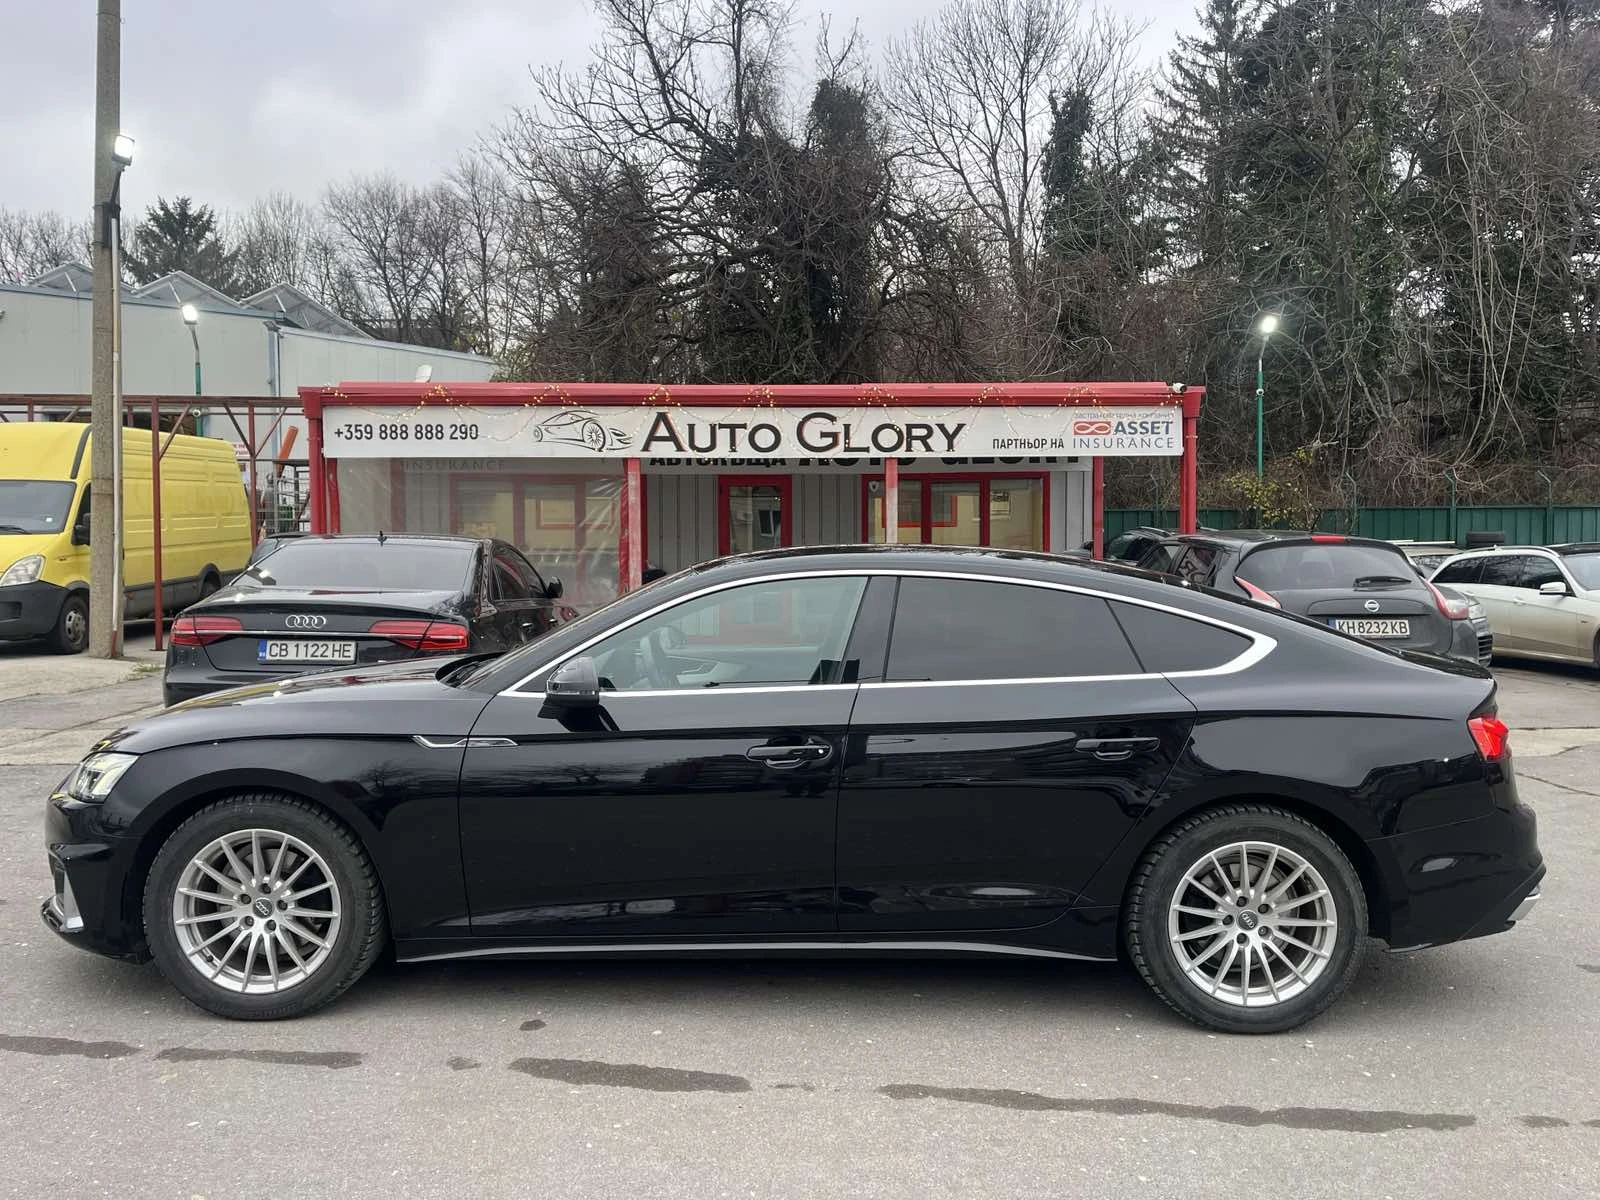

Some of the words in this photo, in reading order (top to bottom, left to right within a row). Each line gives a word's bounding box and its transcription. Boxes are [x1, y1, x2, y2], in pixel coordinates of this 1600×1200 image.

[334, 424, 374, 440] +359
[379, 424, 409, 440] 888
[414, 424, 445, 440] 888
[449, 424, 479, 440] 290
[640, 412, 782, 453] AUTO
[796, 411, 967, 453] GLORY
[1113, 421, 1174, 435] ASSET
[993, 438, 1047, 449] ПАРТНЬОР
[1050, 438, 1065, 449] НА
[1072, 437, 1174, 449] INSURANCE
